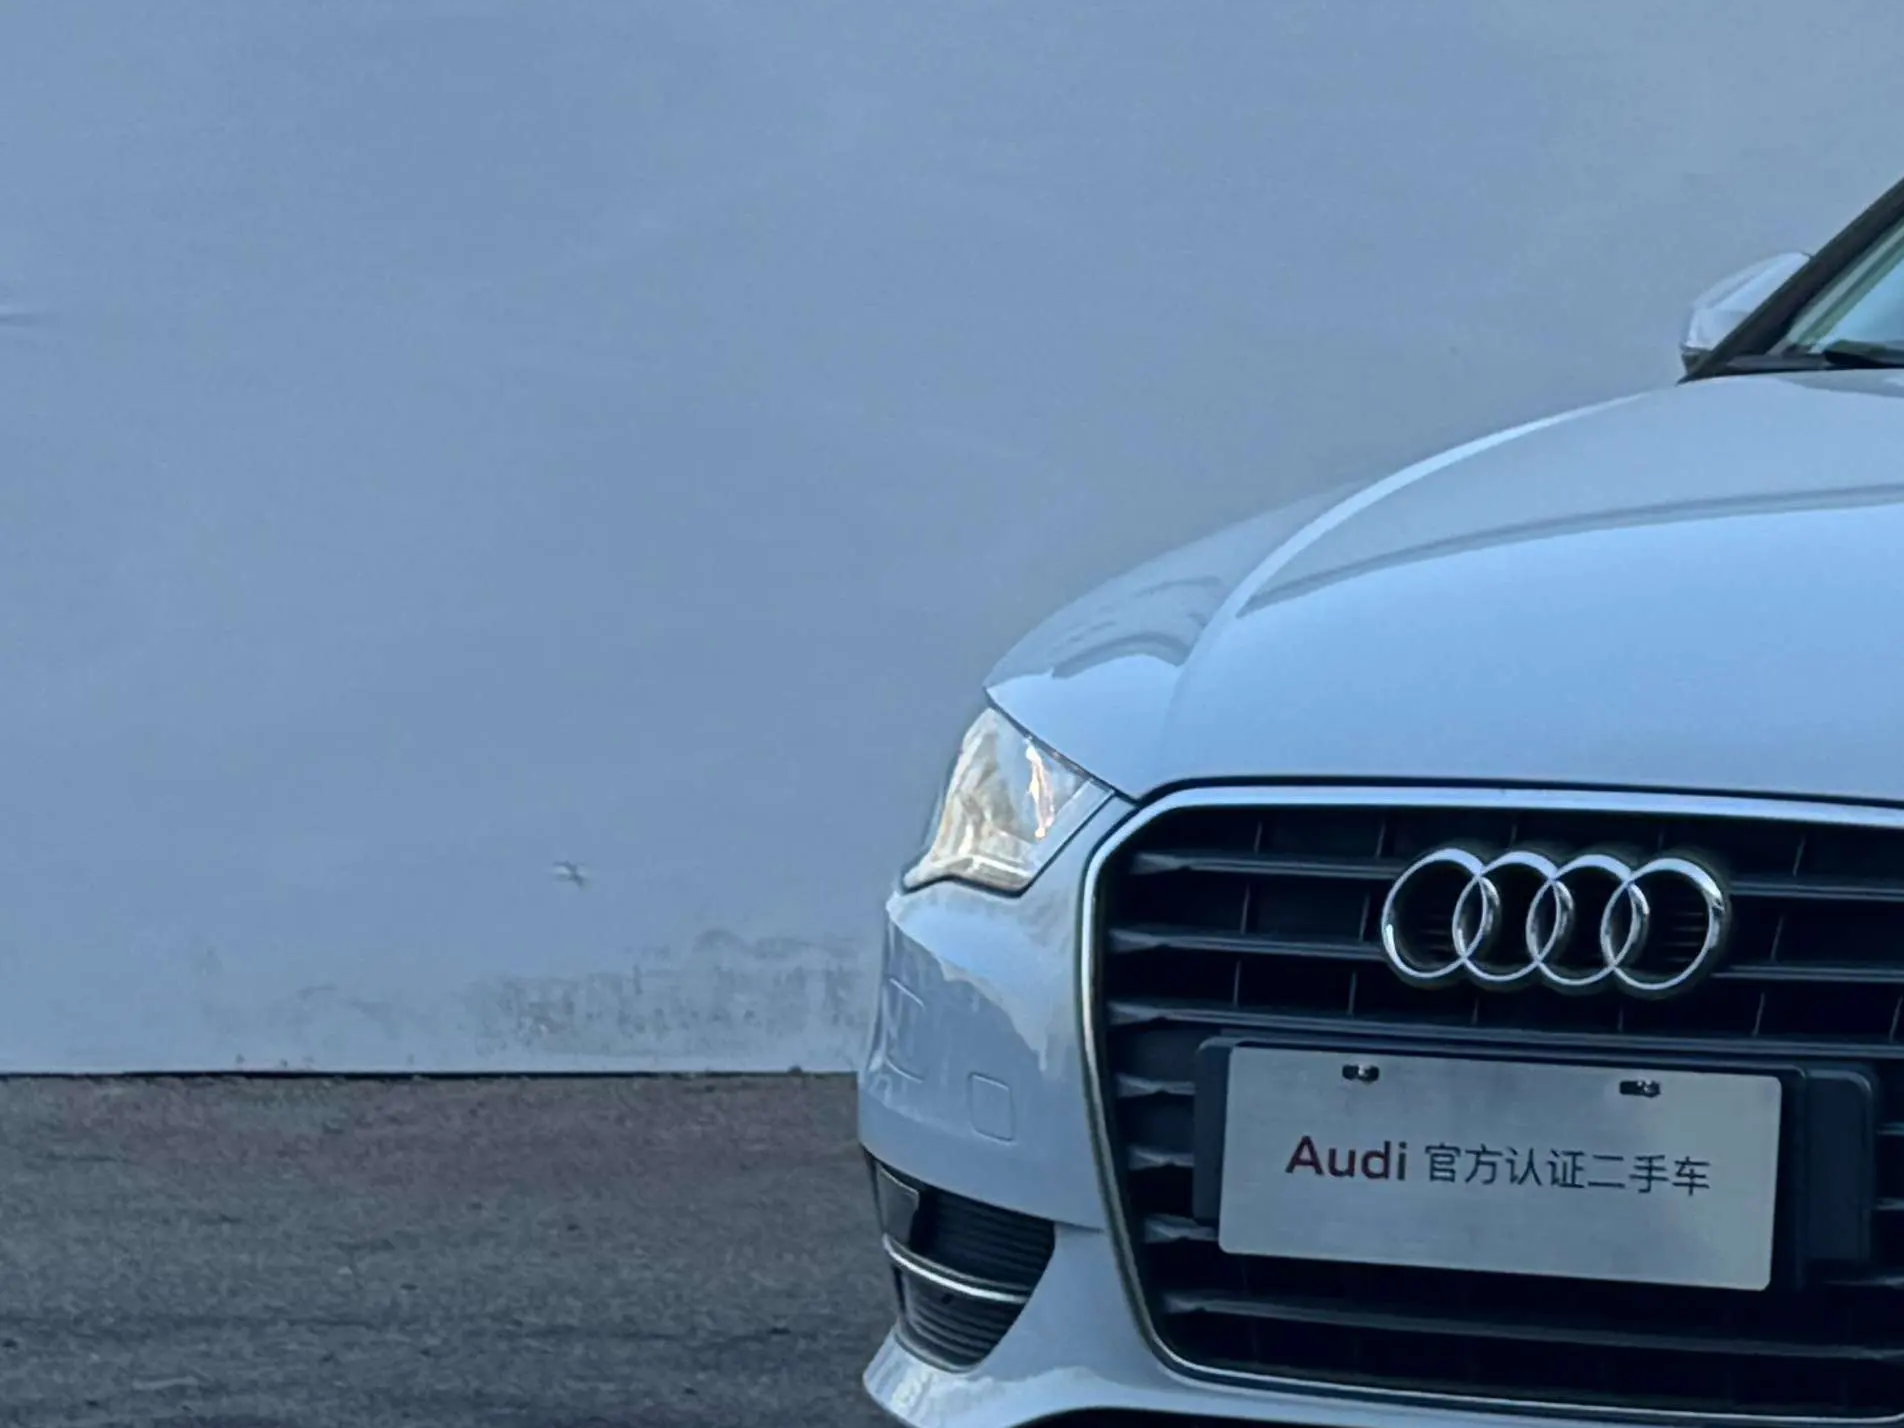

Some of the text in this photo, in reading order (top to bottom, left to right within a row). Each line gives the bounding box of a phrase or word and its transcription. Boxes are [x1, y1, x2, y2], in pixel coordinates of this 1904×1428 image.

[1285, 1135, 1712, 1197] Audi 官方认证二手车
